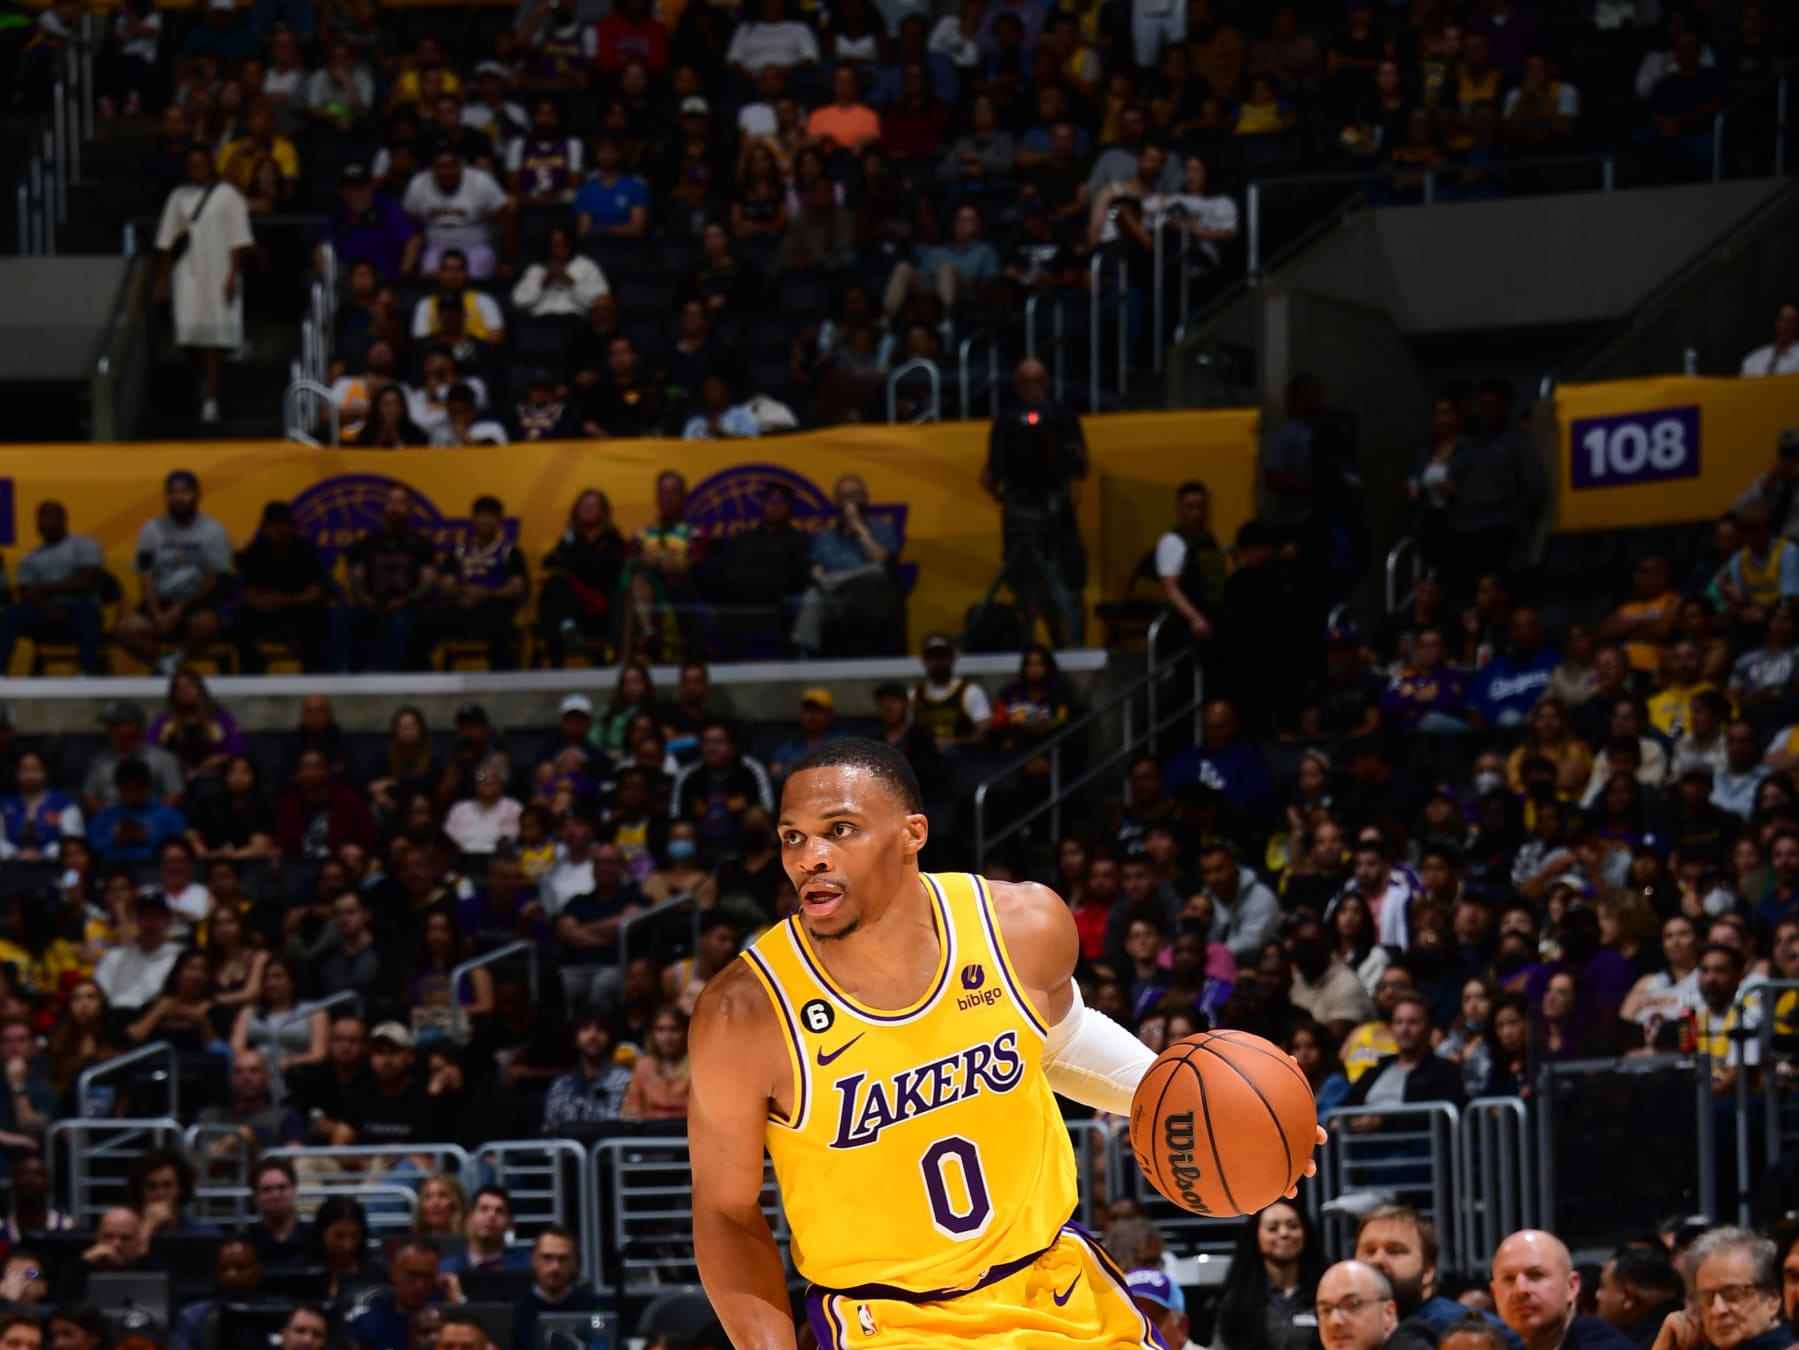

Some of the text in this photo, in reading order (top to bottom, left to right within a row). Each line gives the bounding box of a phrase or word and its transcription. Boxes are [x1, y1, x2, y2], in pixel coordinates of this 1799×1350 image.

[1581, 417, 1689, 479] 108
[807, 1003, 829, 1031] 6
[957, 987, 1002, 1011] bibigo
[828, 1029, 1025, 1150] LAKERS
[919, 1134, 995, 1243] 0
[1164, 1110, 1213, 1214] Wilson
